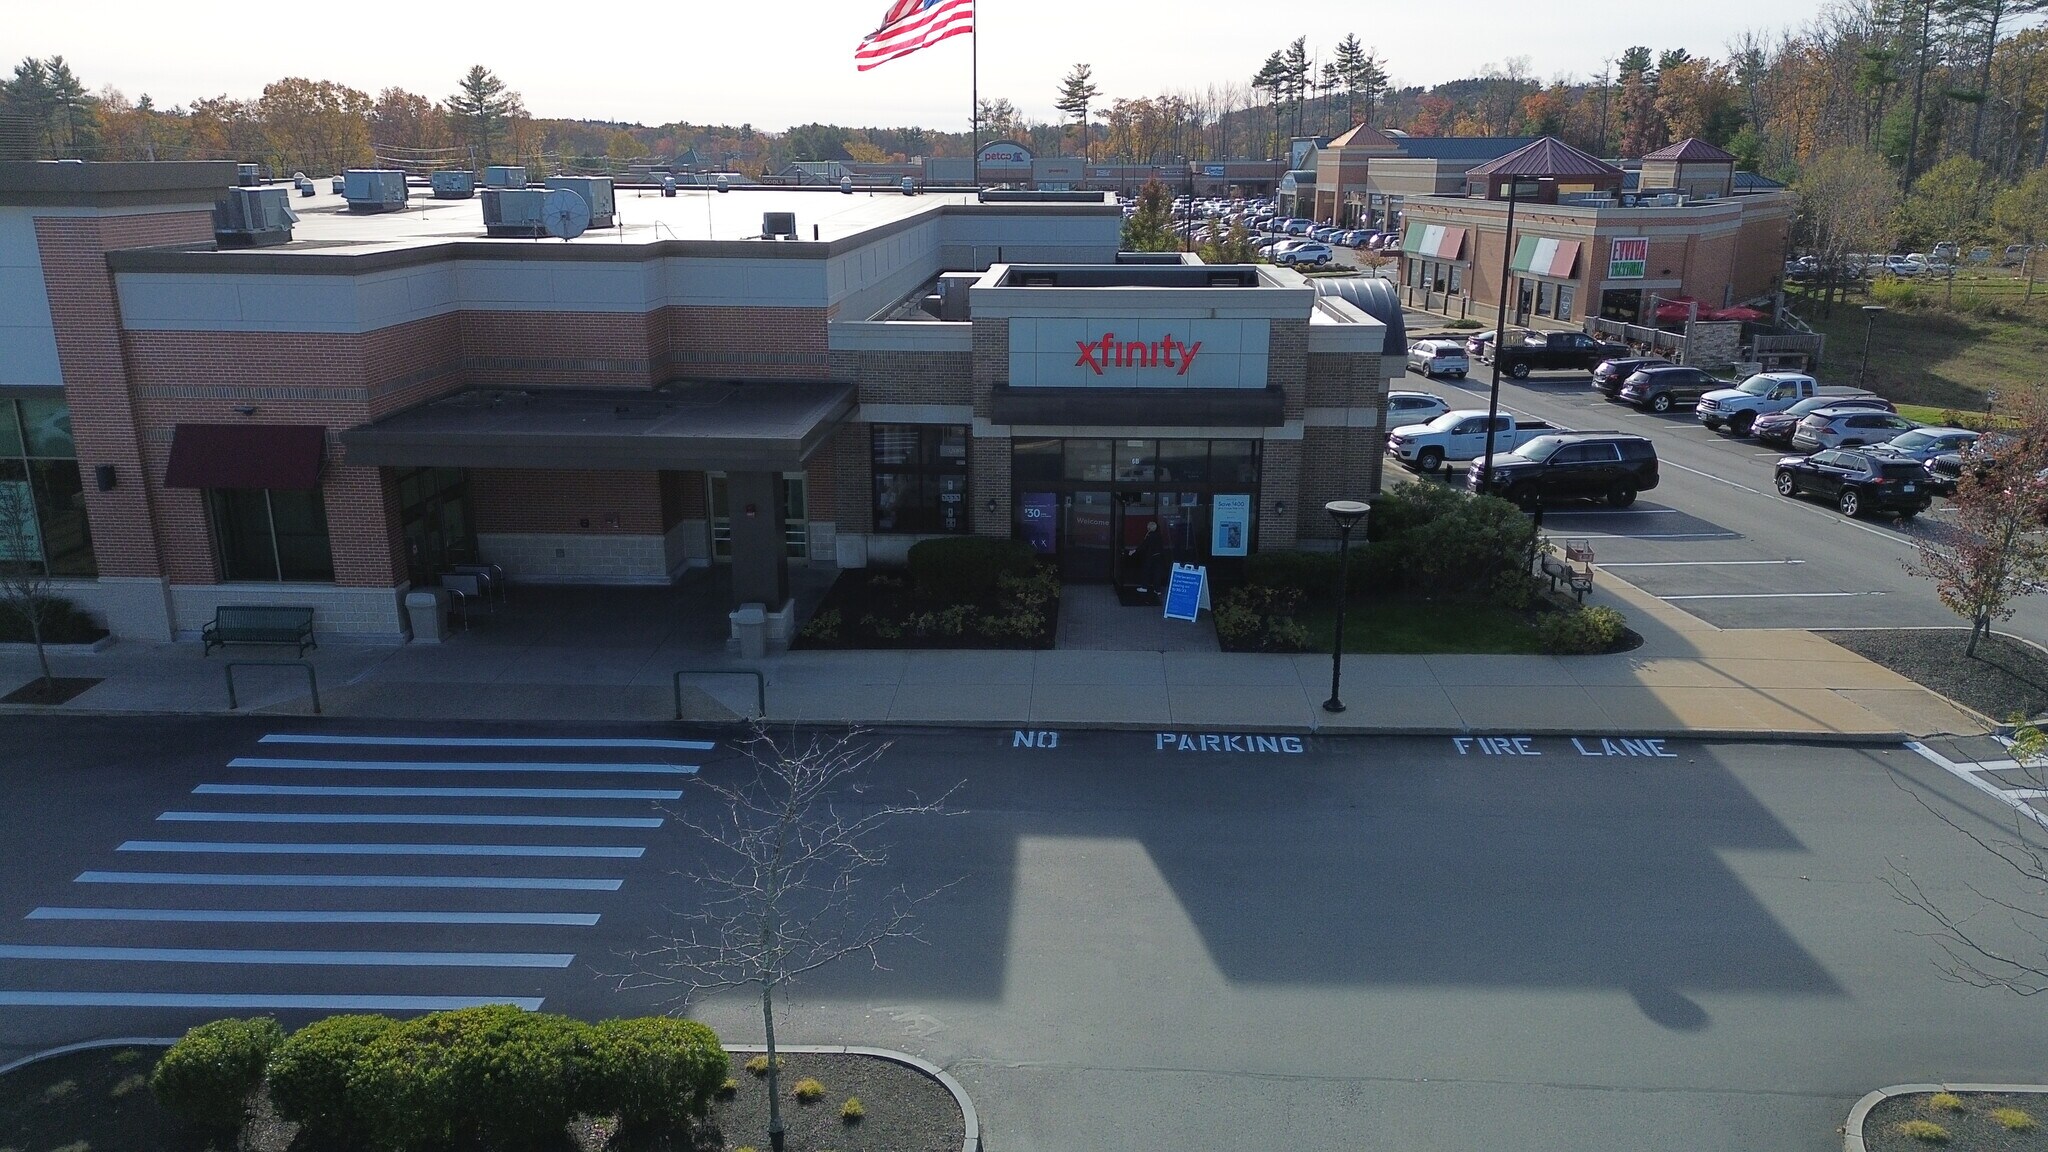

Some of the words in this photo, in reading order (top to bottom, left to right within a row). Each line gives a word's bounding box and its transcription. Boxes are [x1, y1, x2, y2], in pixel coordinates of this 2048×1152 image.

[985, 152, 1012, 162] petco
[1075, 333, 1202, 375] xfinity
[1076, 517, 1110, 526] Welcome
[1012, 730, 1059, 748] NO
[1155, 733, 1303, 753] PARKING
[1452, 737, 1541, 755] FIRE
[1571, 737, 1677, 757] LANE
